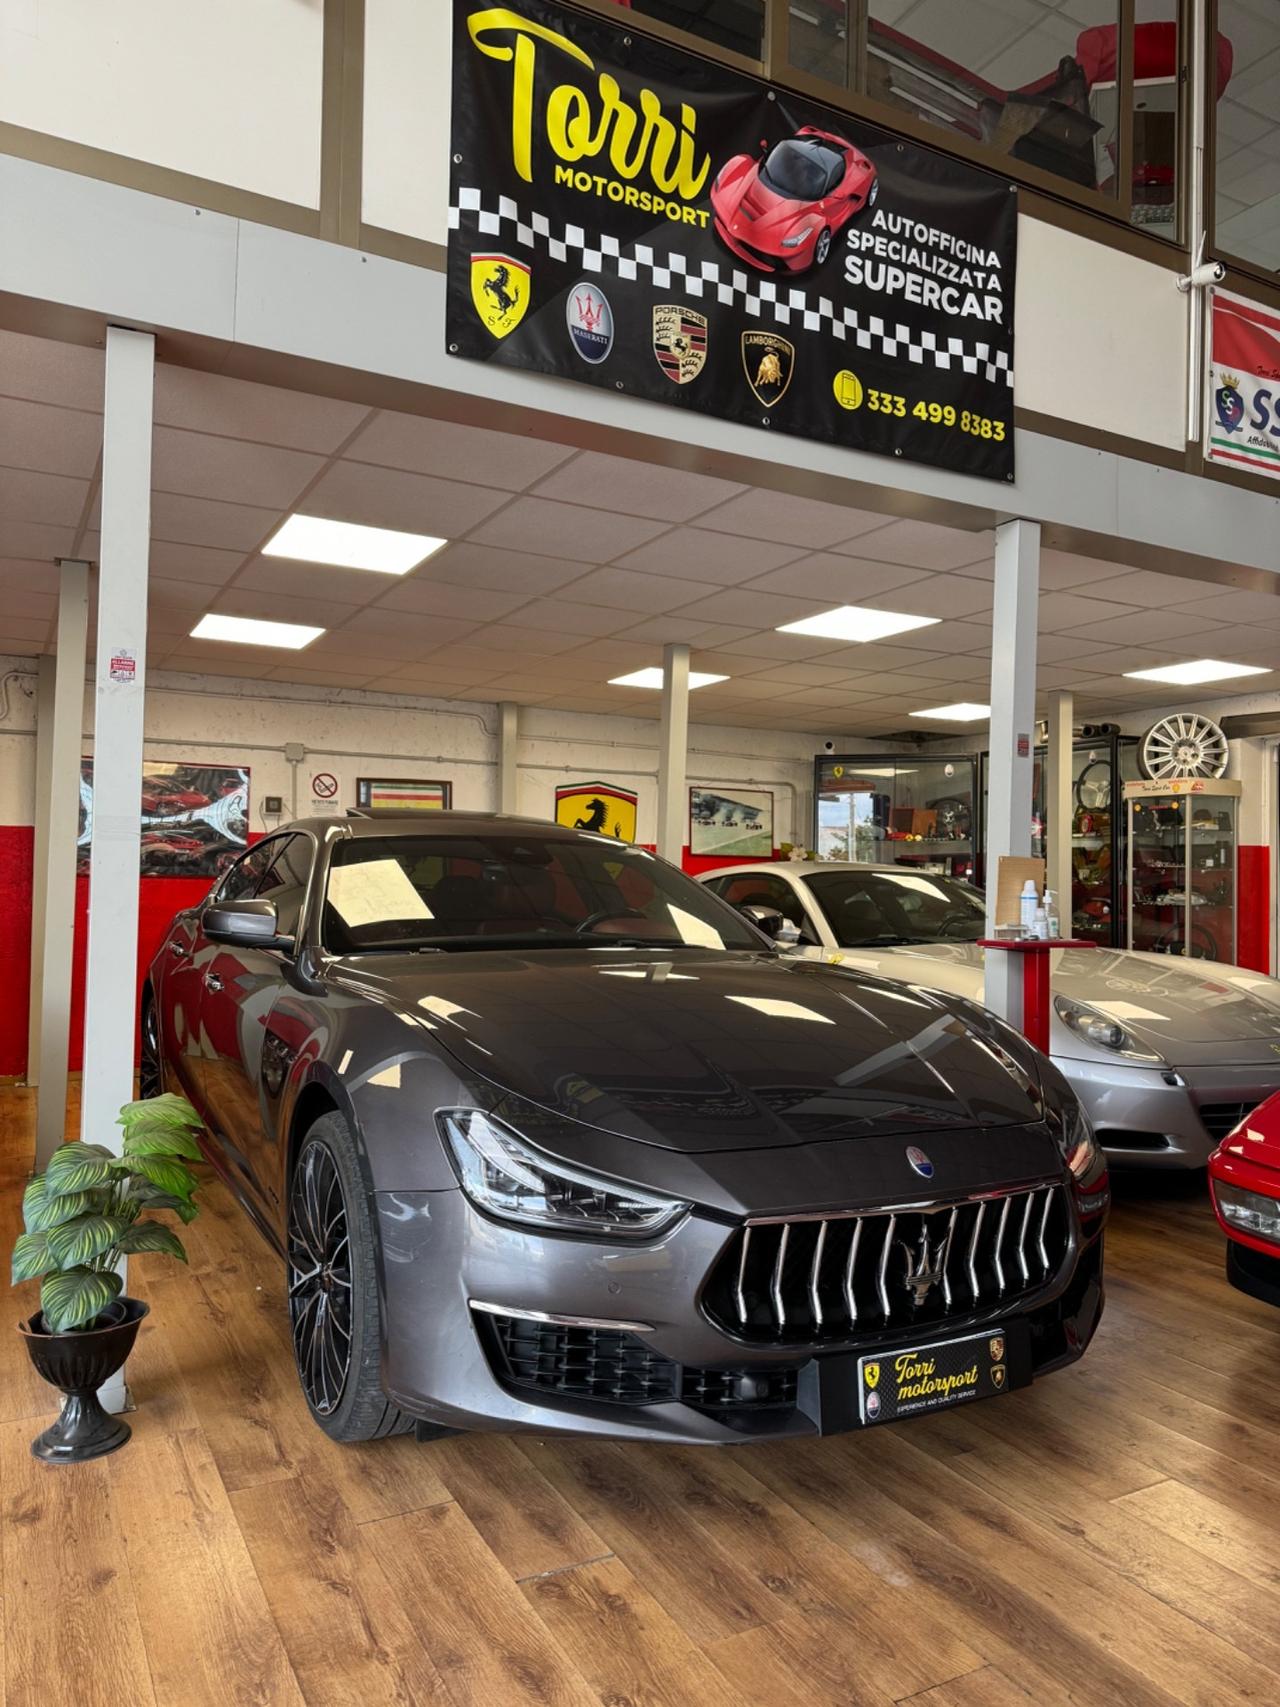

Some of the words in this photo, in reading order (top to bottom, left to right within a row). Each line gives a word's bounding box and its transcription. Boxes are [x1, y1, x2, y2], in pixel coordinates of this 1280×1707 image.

[467, 8, 711, 200] Torri
[555, 165, 710, 228] MOTORSPORT
[847, 228, 1002, 292] SPECIALIZZATA
[872, 209, 1002, 269] AUTOFFICINA
[655, 306, 706, 326] PORSCHE
[844, 254, 1003, 325] SUPERCAR
[573, 328, 608, 345] MASERATI
[867, 388, 907, 417] 333
[912, 401, 956, 427] 499
[960, 410, 1006, 442] 8383
[894, 1353, 936, 1384] Torri
[898, 1366, 978, 1400] motorsport
